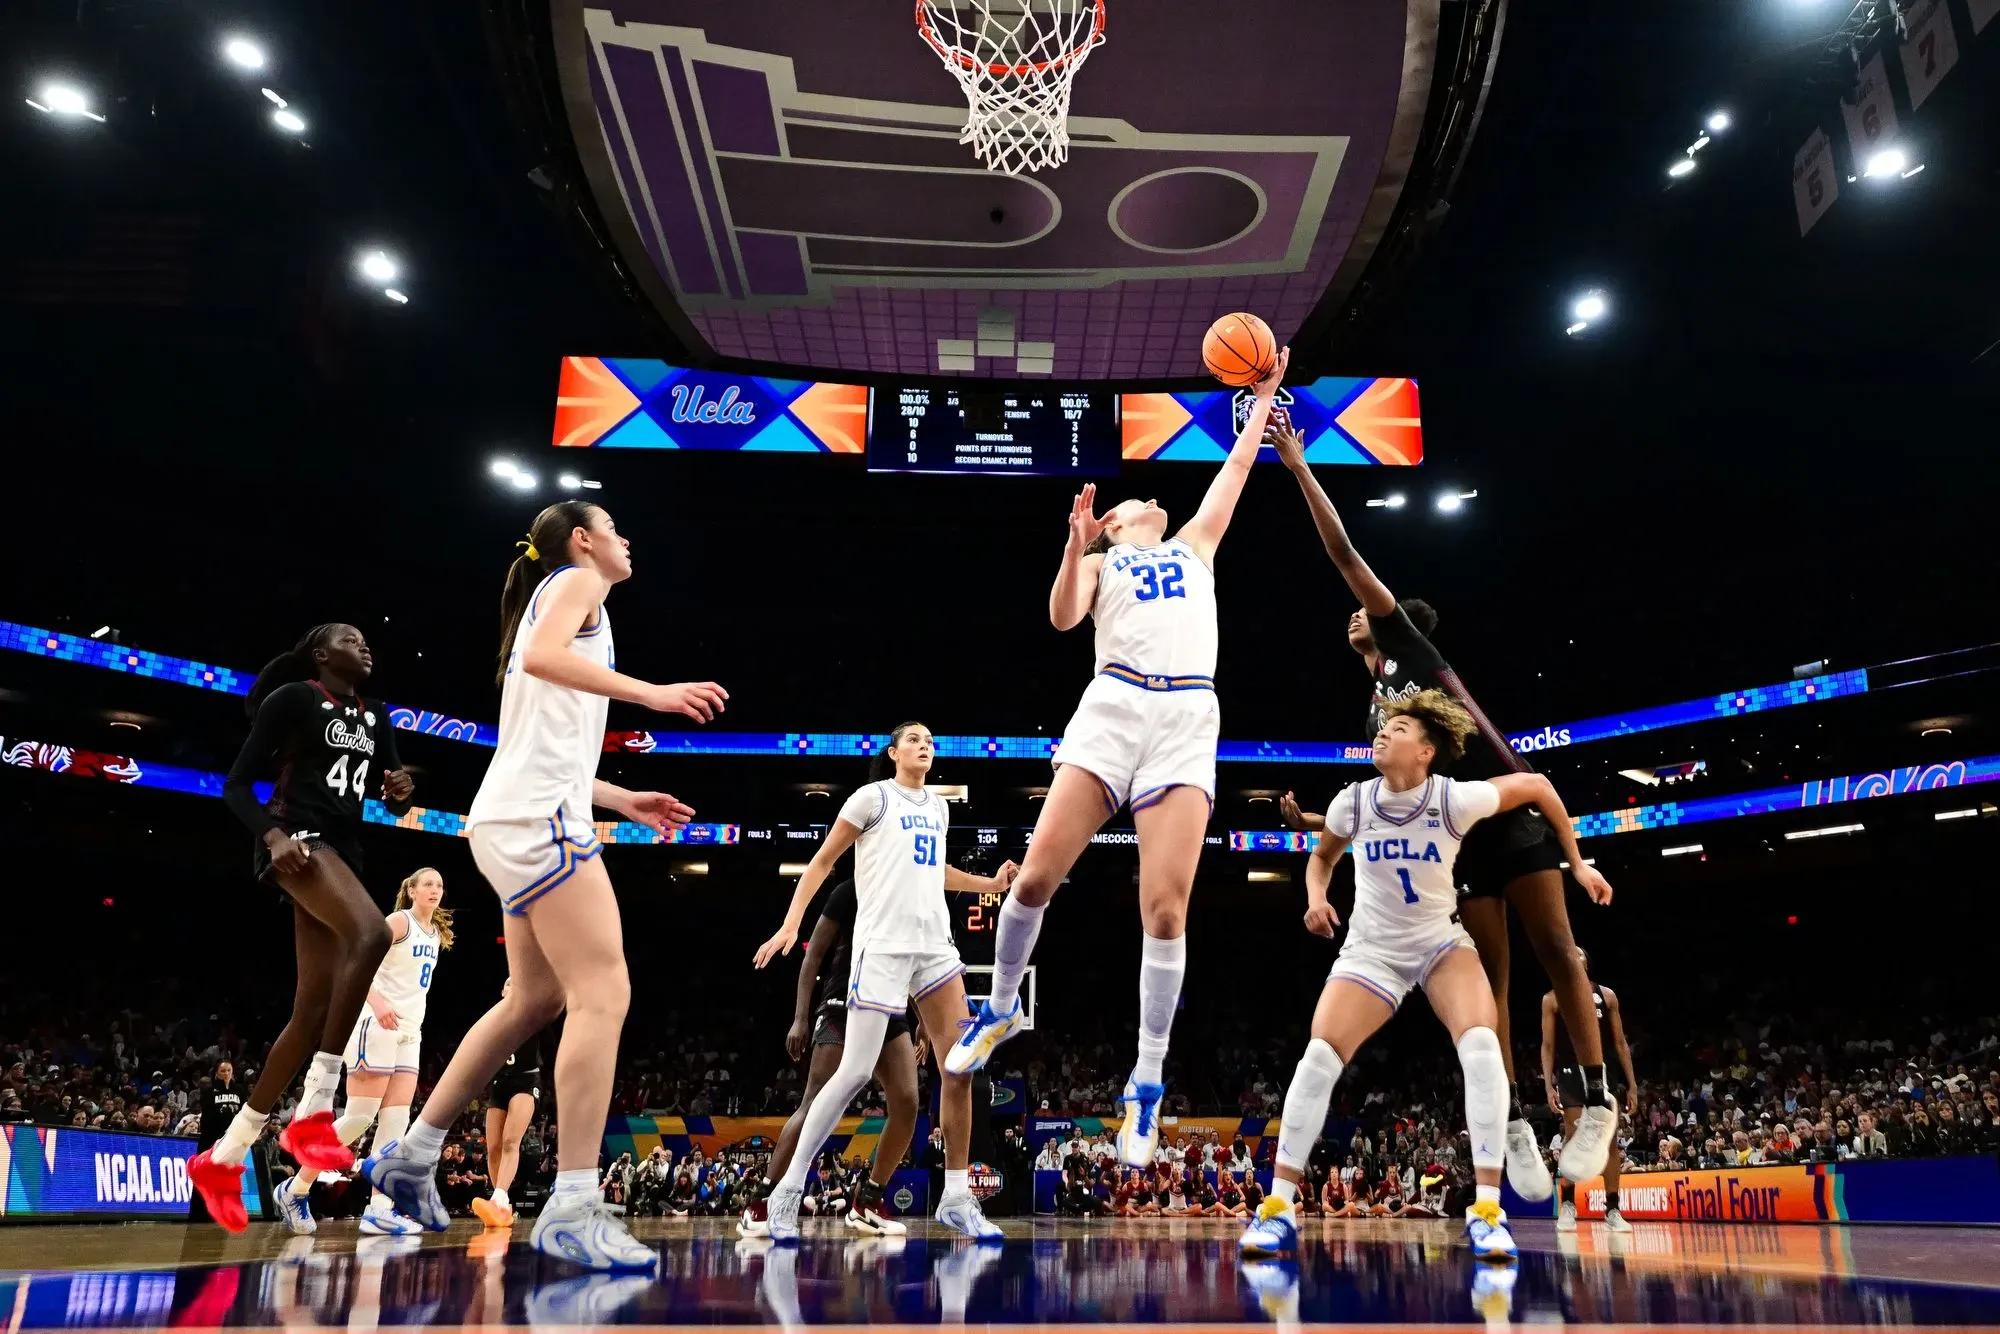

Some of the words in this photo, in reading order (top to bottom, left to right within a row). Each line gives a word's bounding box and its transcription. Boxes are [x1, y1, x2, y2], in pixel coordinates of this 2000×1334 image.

[1862, 104, 1882, 140] 6
[1808, 168, 1824, 208] 5
[672, 384, 755, 424] Ucla
[899, 394, 930, 404] 100.0%
[947, 397, 959, 406] 3/3
[1060, 398, 1090, 408] 100.0%
[901, 406, 925, 416] 28/10
[1005, 411, 1030, 419] FENSIVE
[1064, 410, 1082, 420] 16/7
[909, 418, 918, 428] 10
[1072, 422, 1078, 432] 3
[910, 429, 916, 440] 6
[975, 433, 1013, 441] TURNOVERS
[1072, 433, 1078, 443] 2
[956, 445, 979, 453] POINTS
[994, 445, 1032, 454] TURNOVERS
[1071, 445, 1078, 455] 4
[907, 452, 917, 463] 10
[955, 456, 981, 464] SECOND
[1008, 457, 1033, 465] POINTS
[1072, 457, 1078, 466] 2
[1112, 549, 1190, 572] UCLA
[1130, 562, 1186, 601] 32
[1510, 726, 1571, 753] cocks
[1344, 747, 1373, 759] SOUT
[326, 754, 369, 802] 44
[900, 815, 943, 832] UCLA
[766, 830, 771, 839] 3
[787, 831, 812, 839] TIMEOUTS
[813, 831, 818, 839] 3
[977, 834, 998, 844] 1:04
[914, 834, 937, 866] 51
[1365, 839, 1442, 863] UCLA
[1397, 868, 1419, 904] 1
[979, 893, 1001, 906] 1:04
[413, 945, 438, 960] UCL
[420, 963, 431, 988] 8
[1035, 1121, 1071, 1131] ESPN
[979, 1176, 1001, 1187] FOUR
[1618, 1188, 1630, 1211] AA
[1631, 1186, 1668, 1211] WOMEN'S
[1674, 1175, 1723, 1219] Final
[1728, 1177, 1780, 1220] Four
